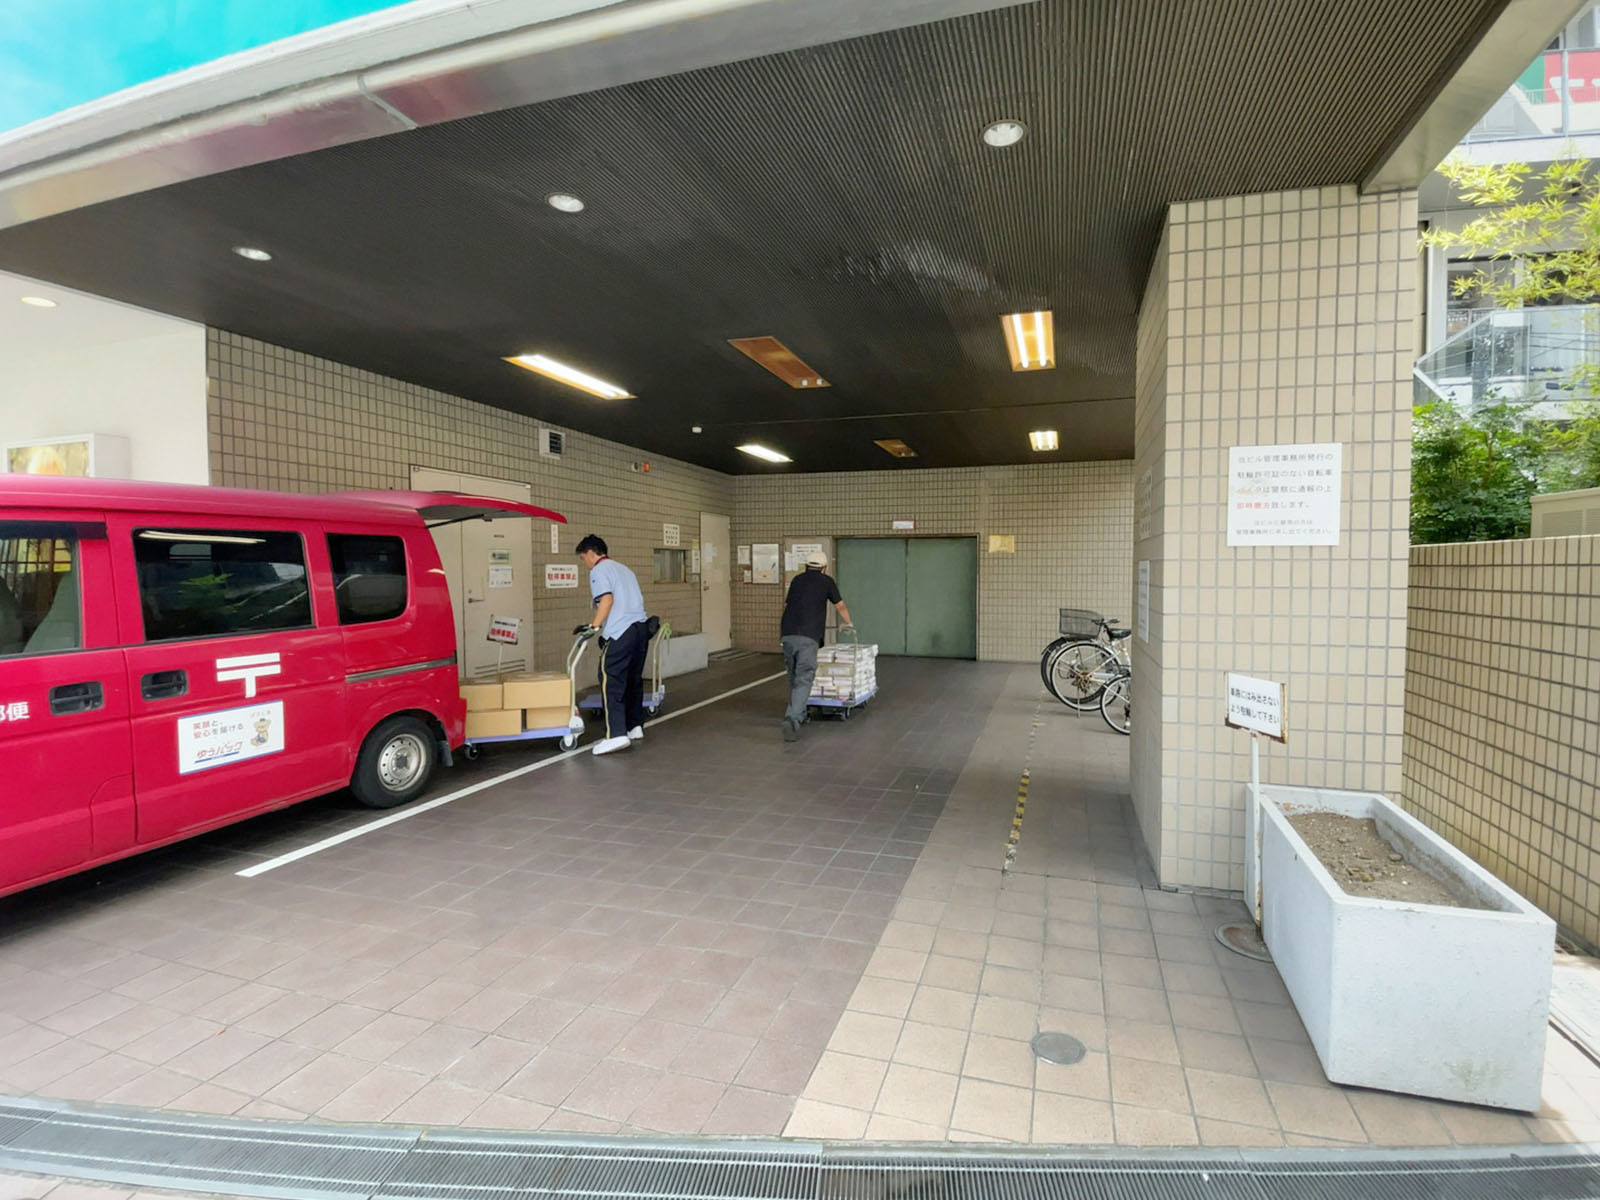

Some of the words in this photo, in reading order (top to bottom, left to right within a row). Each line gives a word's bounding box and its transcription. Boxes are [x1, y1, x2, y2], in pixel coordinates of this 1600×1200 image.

[1237, 468, 1332, 479] 駐輪許可証のない自転車
[1230, 704, 1280, 724] よう駐輪して下さい
[193, 723, 244, 739] 安心を届ける
[196, 741, 243, 759] ゆうパック
